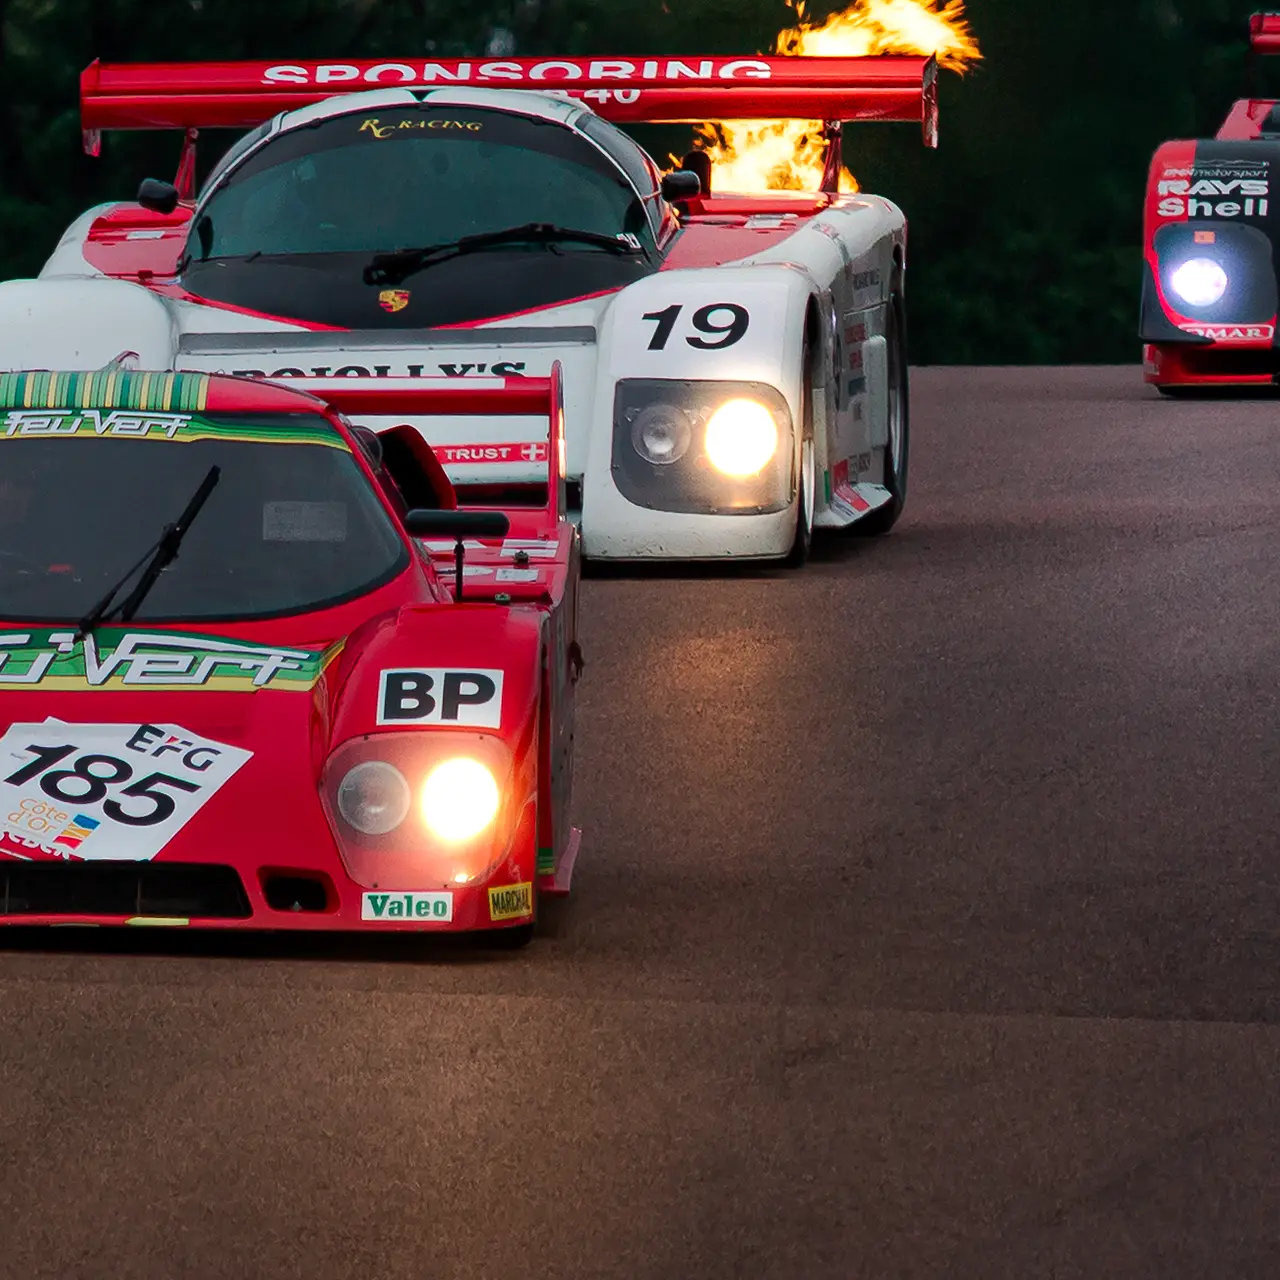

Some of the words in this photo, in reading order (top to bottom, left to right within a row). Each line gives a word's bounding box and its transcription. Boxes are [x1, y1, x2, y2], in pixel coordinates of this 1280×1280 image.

[260, 60, 772, 84] SPONSORING
[398, 120, 483, 131] RACING
[1157, 179, 1269, 195] RAYS
[1157, 198, 1269, 216] Shell
[641, 302, 750, 350] 19
[445, 448, 511, 460] TRUST
[383, 672, 496, 720] BP
[125, 724, 222, 772] EFG
[3, 744, 202, 827] 185
[19, 797, 69, 823] Côte
[7, 810, 58, 835] d'Or
[367, 895, 448, 918] Valeo
